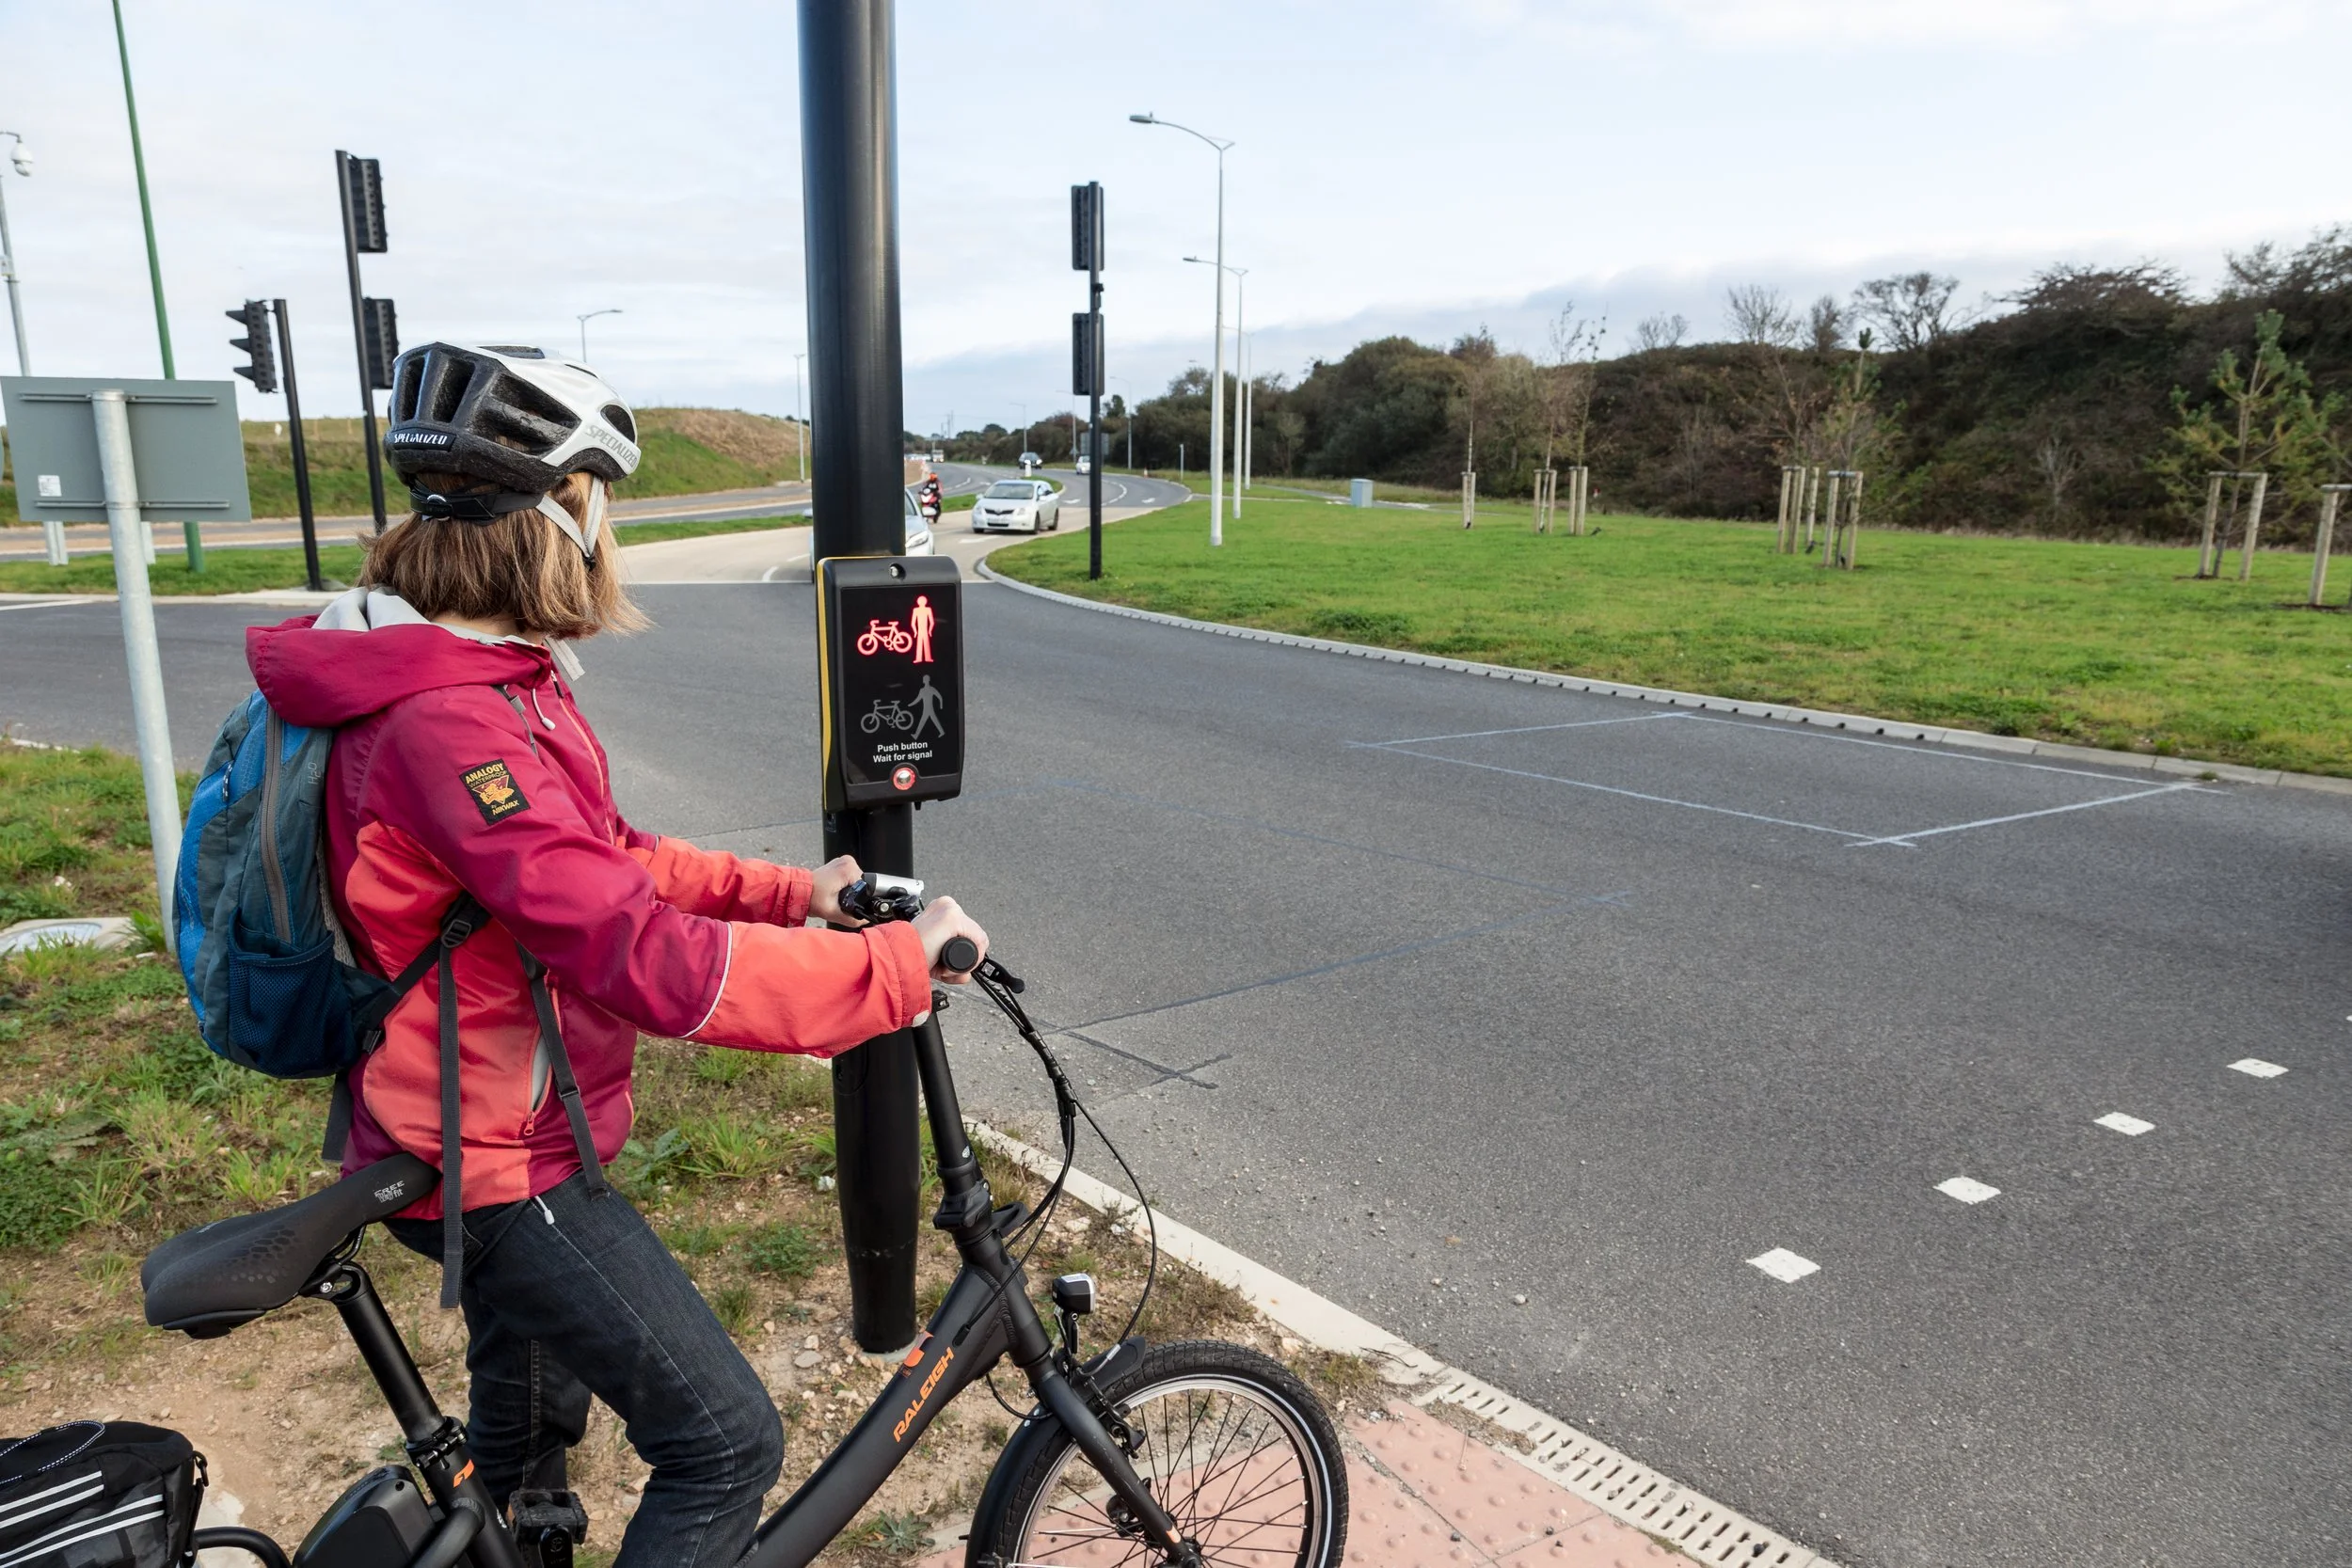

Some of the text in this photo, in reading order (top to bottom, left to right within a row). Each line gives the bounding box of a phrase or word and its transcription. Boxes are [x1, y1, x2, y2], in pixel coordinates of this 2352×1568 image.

[394, 433, 448, 445] SPECIALIZED
[585, 424, 638, 468] SPECIALIZED
[877, 741, 929, 752] Push button
[873, 753, 892, 763] Wait
[907, 750, 932, 761] signal
[465, 763, 505, 784] ANALOGY
[469, 769, 507, 788] WATERPROOF
[492, 800, 519, 816] NIKWAX
[893, 1346, 954, 1443] RALEIGH
